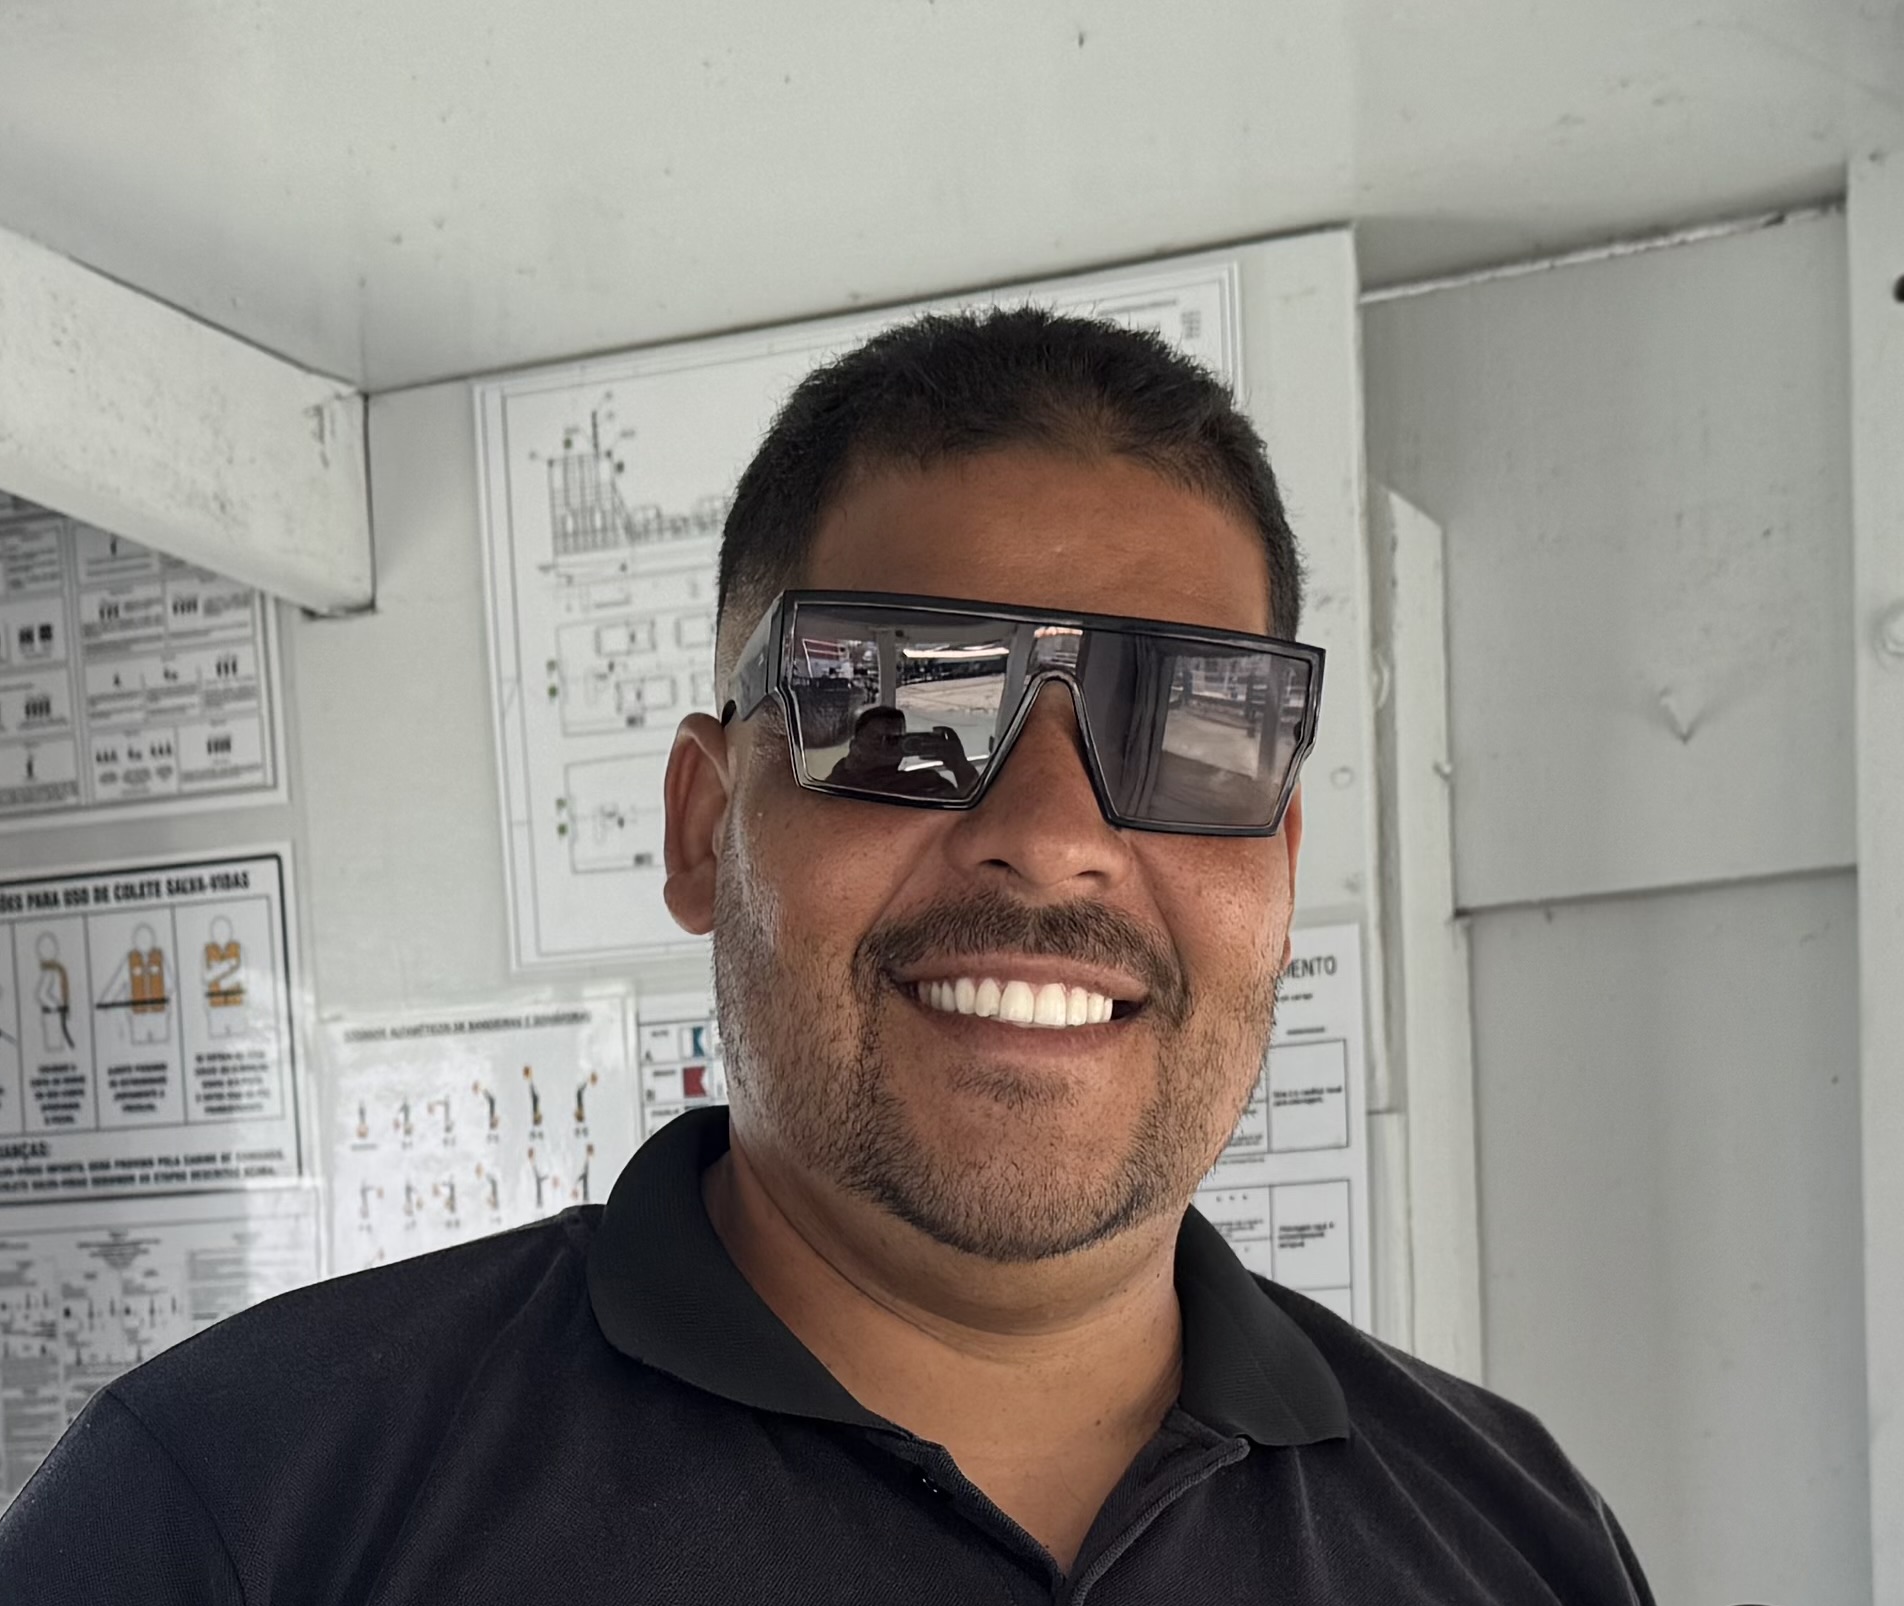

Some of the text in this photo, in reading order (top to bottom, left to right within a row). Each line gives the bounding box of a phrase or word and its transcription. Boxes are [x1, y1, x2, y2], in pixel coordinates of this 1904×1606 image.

[27, 889, 59, 911] PARA
[95, 884, 109, 904] DE
[113, 880, 162, 903] COLETE
